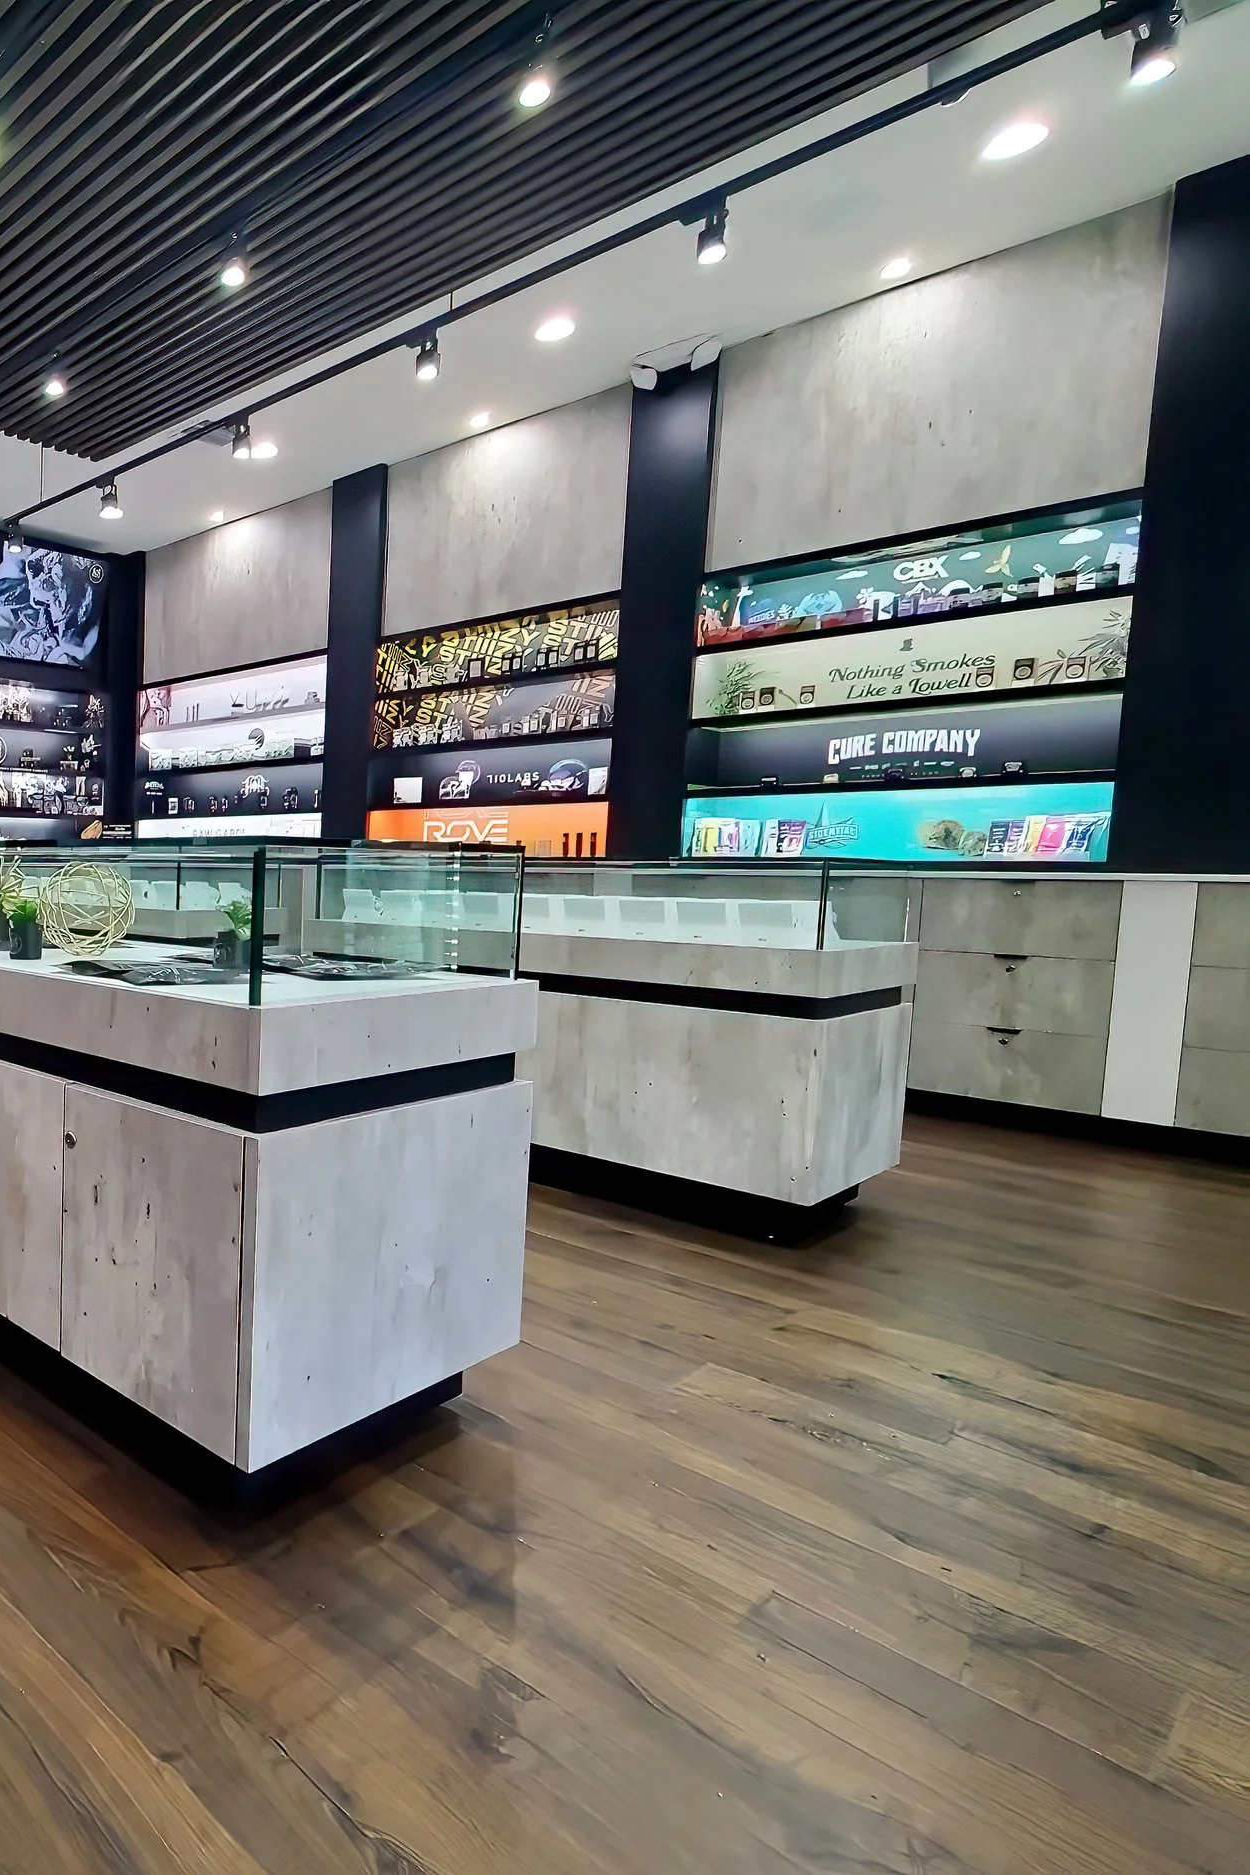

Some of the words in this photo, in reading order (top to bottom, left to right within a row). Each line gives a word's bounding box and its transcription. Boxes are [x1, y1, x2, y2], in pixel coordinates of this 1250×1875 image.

[892, 554, 950, 581] CBX
[828, 663, 906, 683] Nothing
[910, 652, 996, 674] Smokes
[846, 683, 887, 700] Like
[891, 684, 902, 695] a
[908, 672, 971, 696] Lowell
[827, 732, 877, 765] CURE
[881, 728, 981, 757] COMPANY
[423, 819, 508, 843] ROVE
